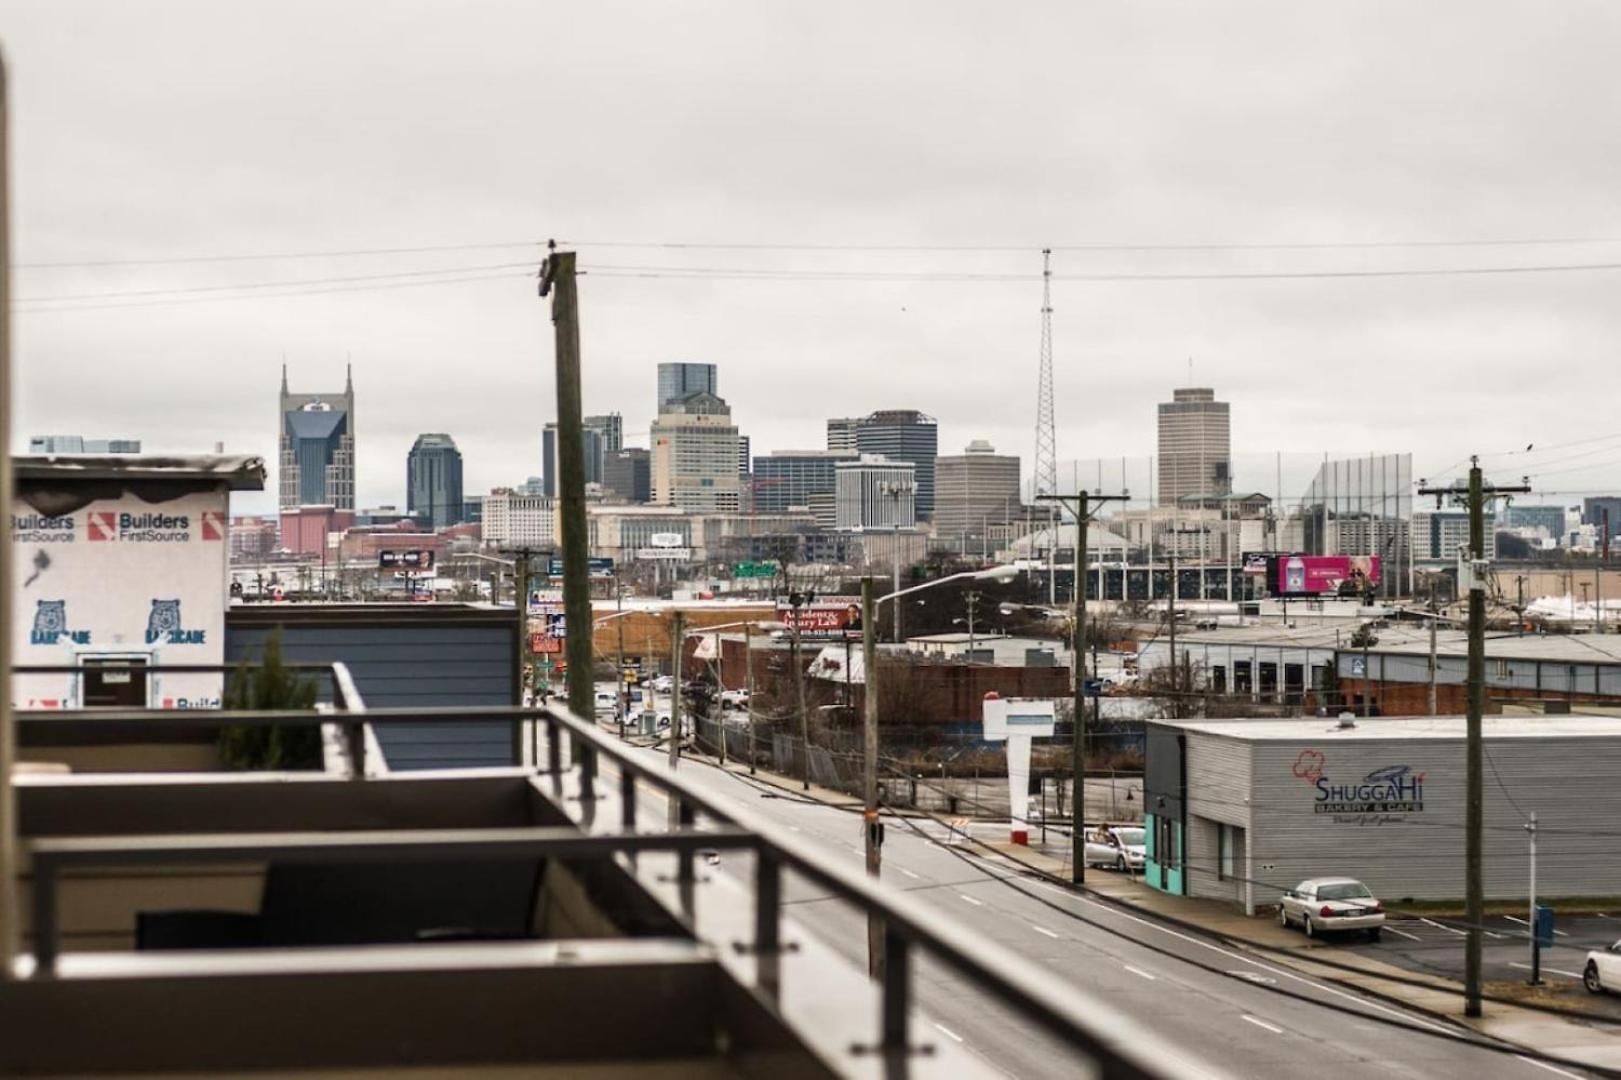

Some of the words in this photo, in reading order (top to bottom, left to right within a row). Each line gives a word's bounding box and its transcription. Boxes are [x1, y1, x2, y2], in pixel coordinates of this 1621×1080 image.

[119, 513, 189, 528] Builders
[119, 530, 189, 542] FirstSource
[818, 618, 839, 626] Law
[1316, 803, 1369, 813] BAKERY
